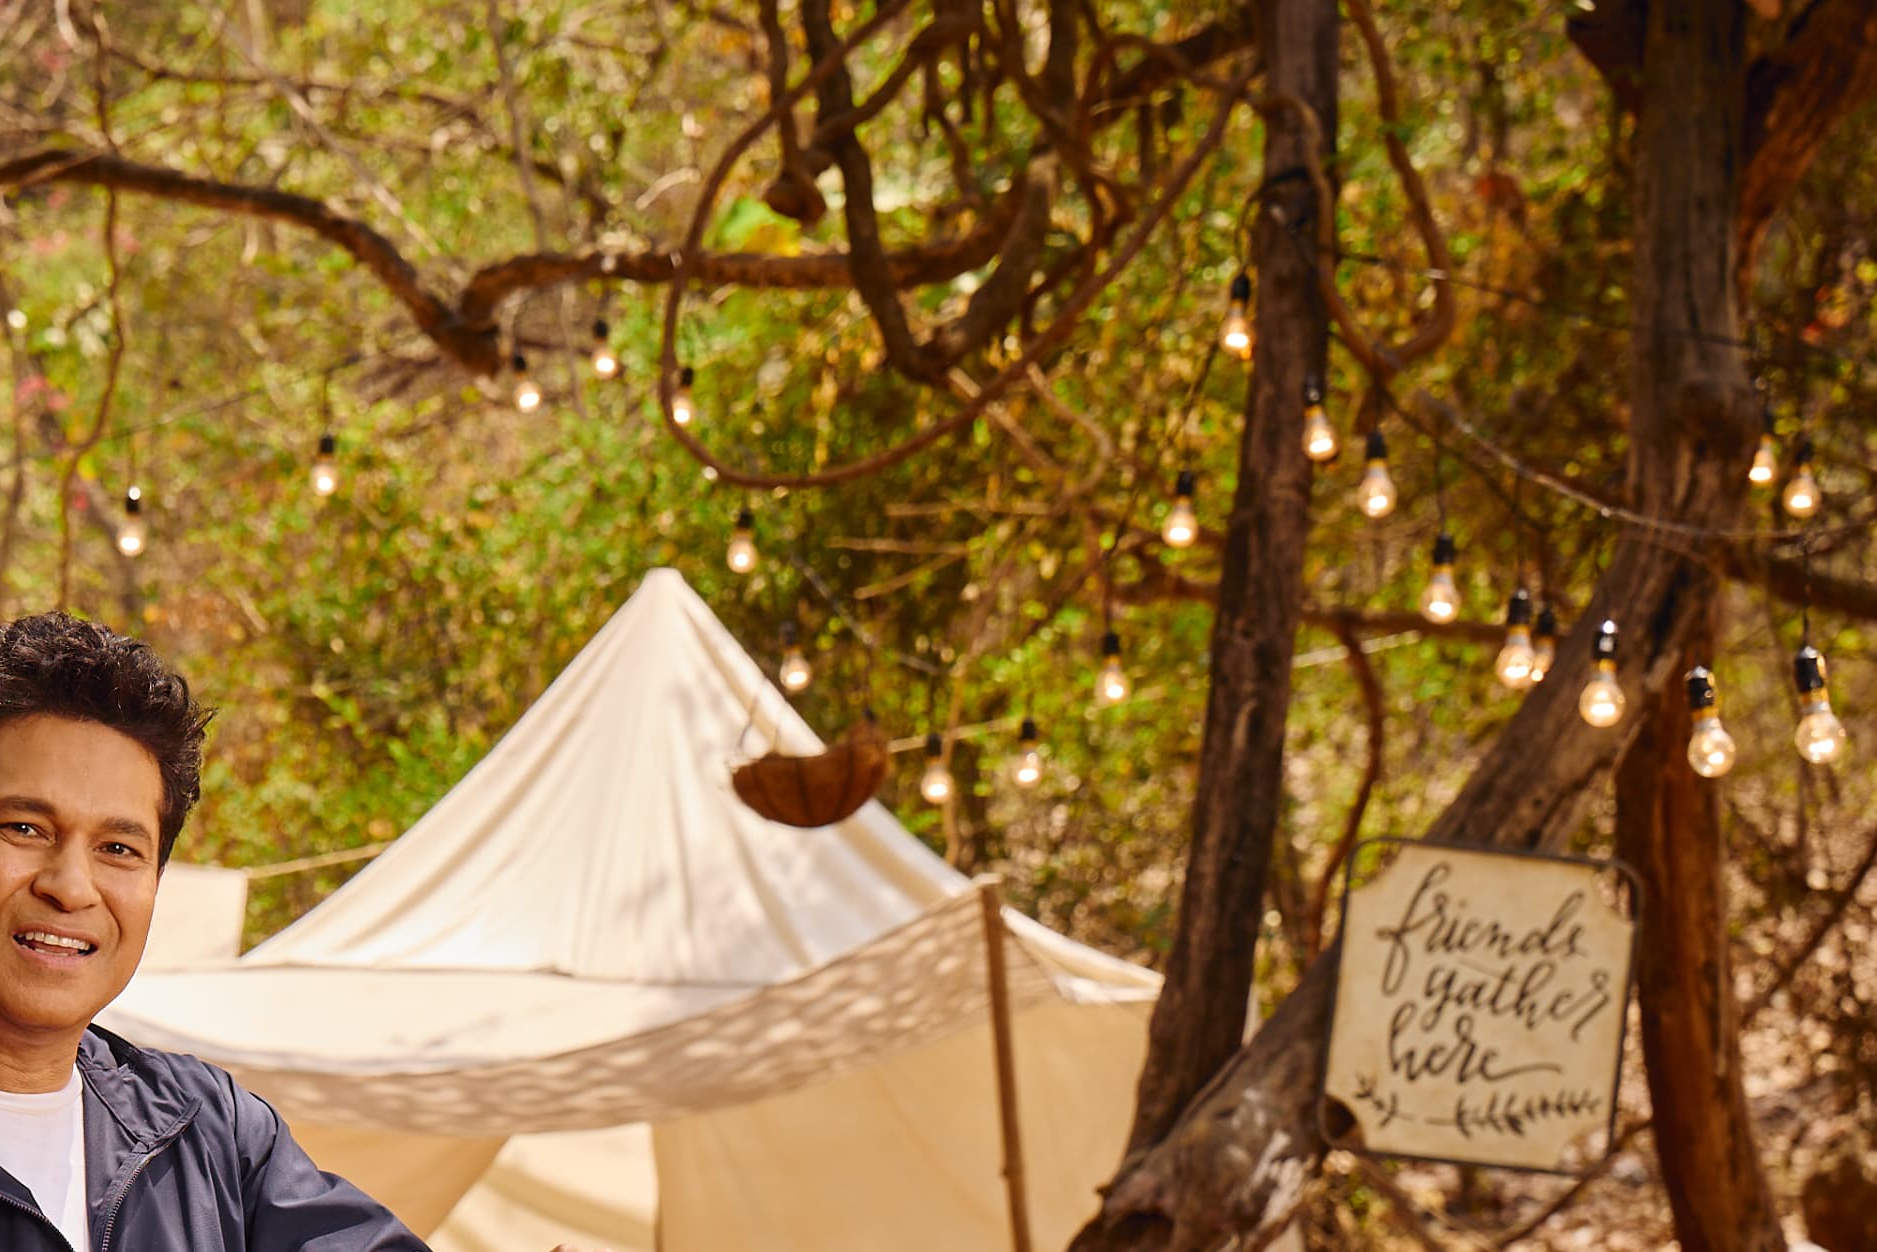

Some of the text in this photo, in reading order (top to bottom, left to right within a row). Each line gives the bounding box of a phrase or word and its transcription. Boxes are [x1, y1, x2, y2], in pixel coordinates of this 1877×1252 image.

[1376, 862, 1588, 996] friends
[1389, 1001, 1561, 1084] here
[1423, 958, 1610, 1043] gather
